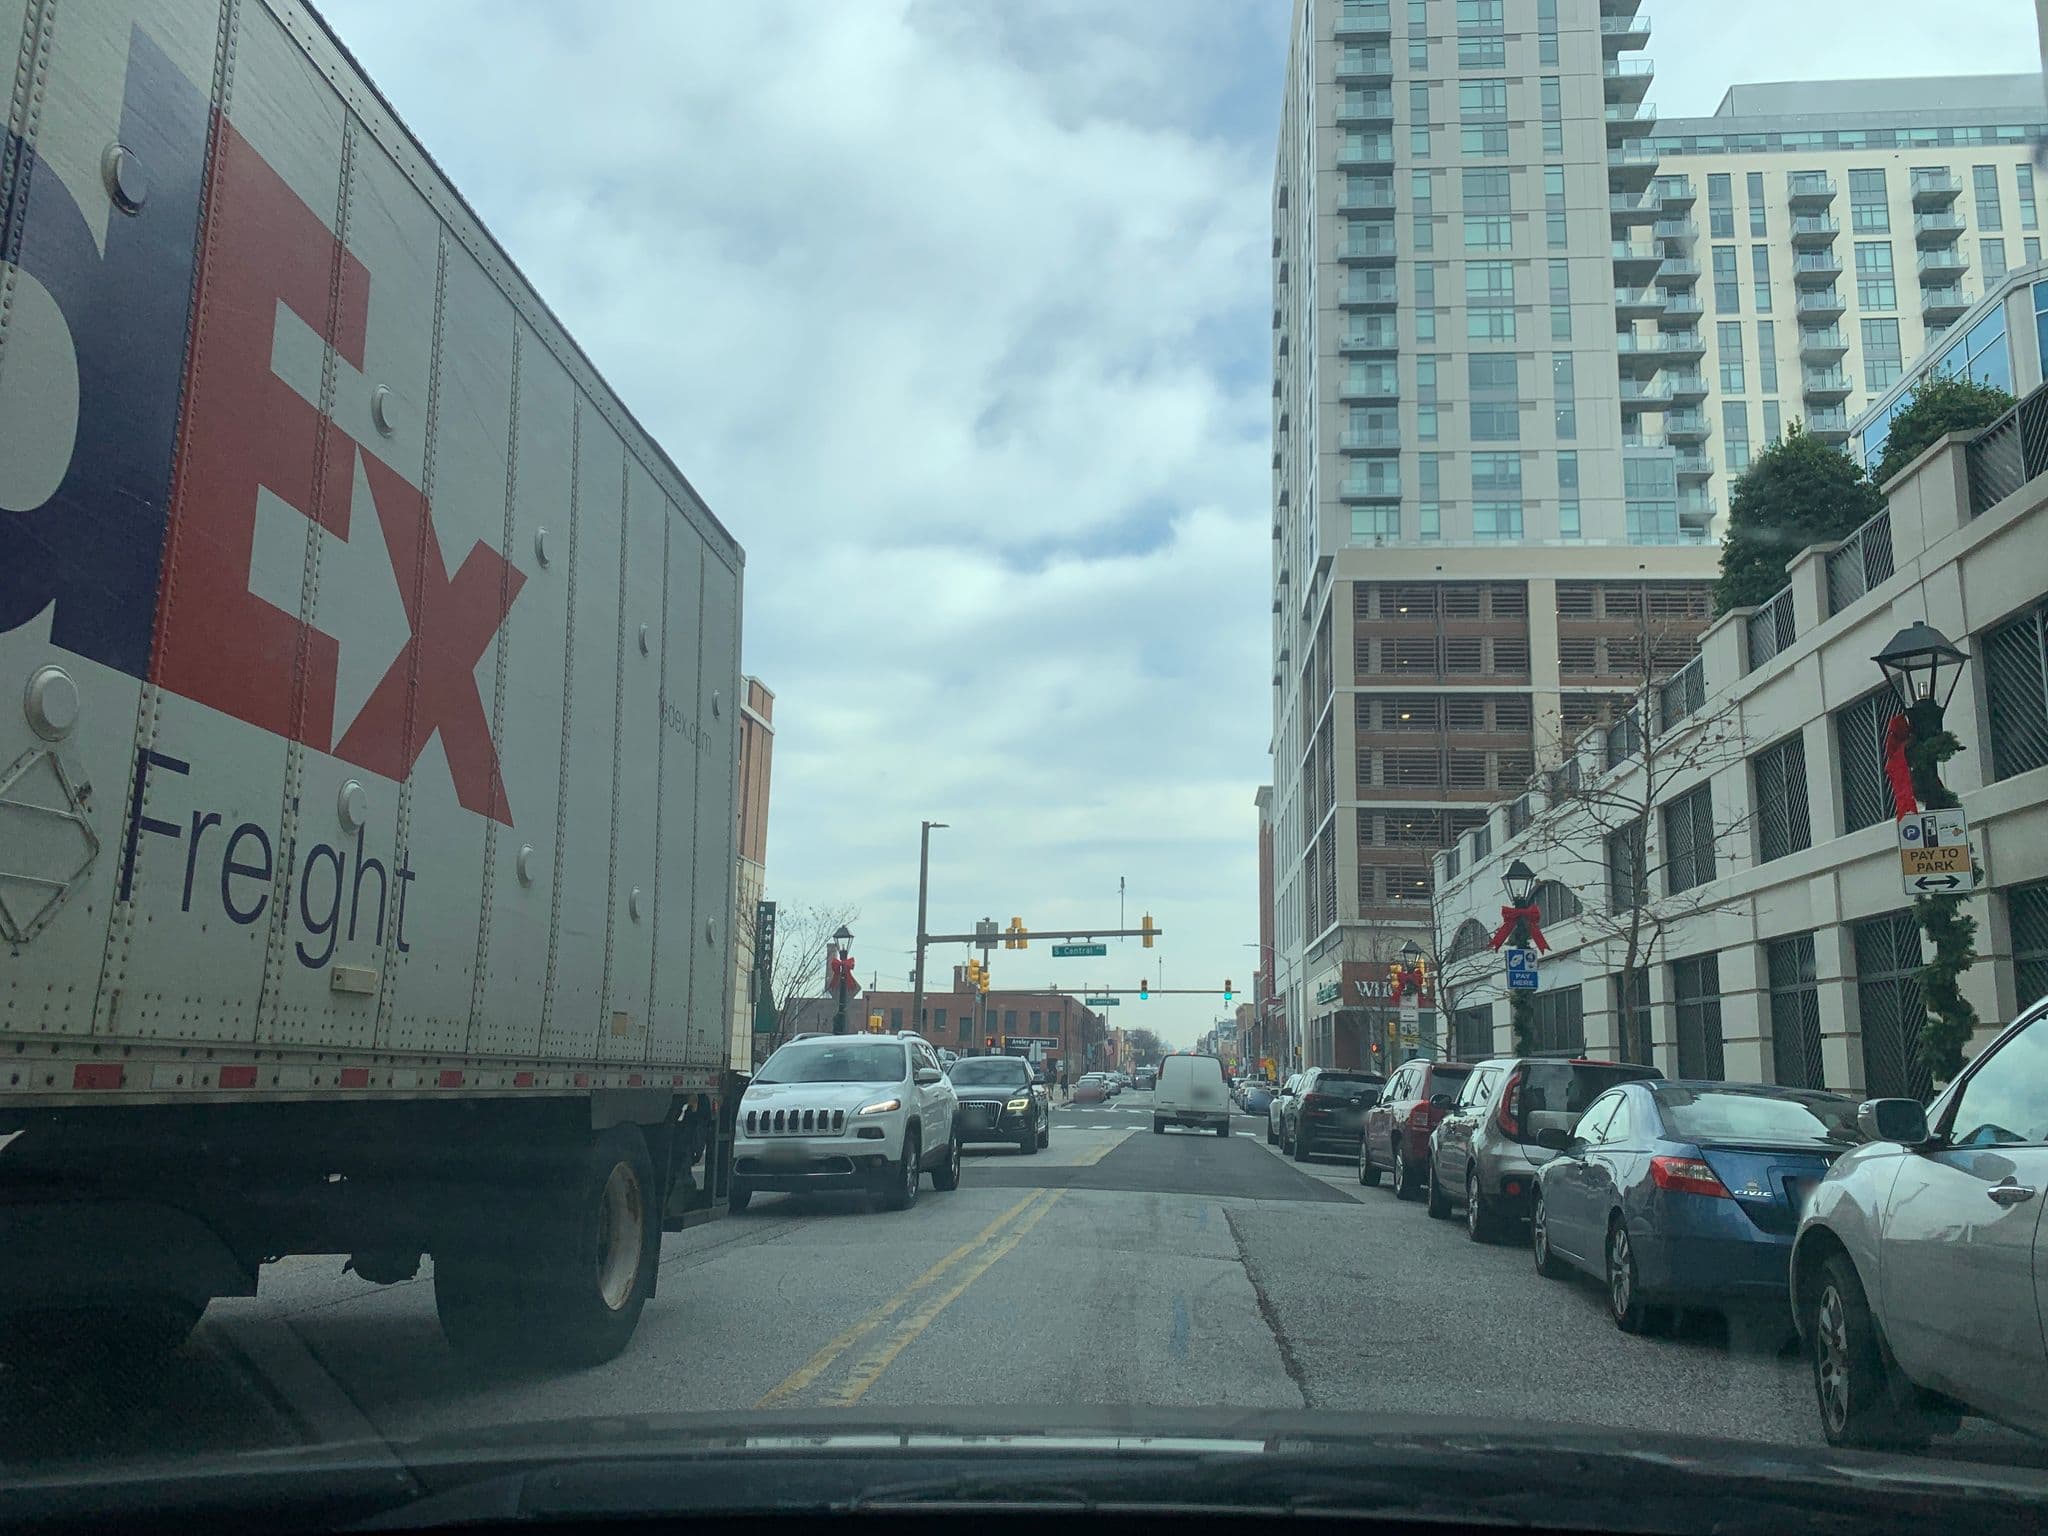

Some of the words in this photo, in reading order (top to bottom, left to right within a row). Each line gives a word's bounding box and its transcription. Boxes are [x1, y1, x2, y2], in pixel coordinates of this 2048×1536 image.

[119, 747, 415, 968] Freight
[1910, 850, 1935, 861] PAY
[1939, 848, 1959, 859] TO
[1917, 860, 1954, 872] PARK
[1054, 947, 1060, 956] S
[1064, 946, 1094, 955] Central
